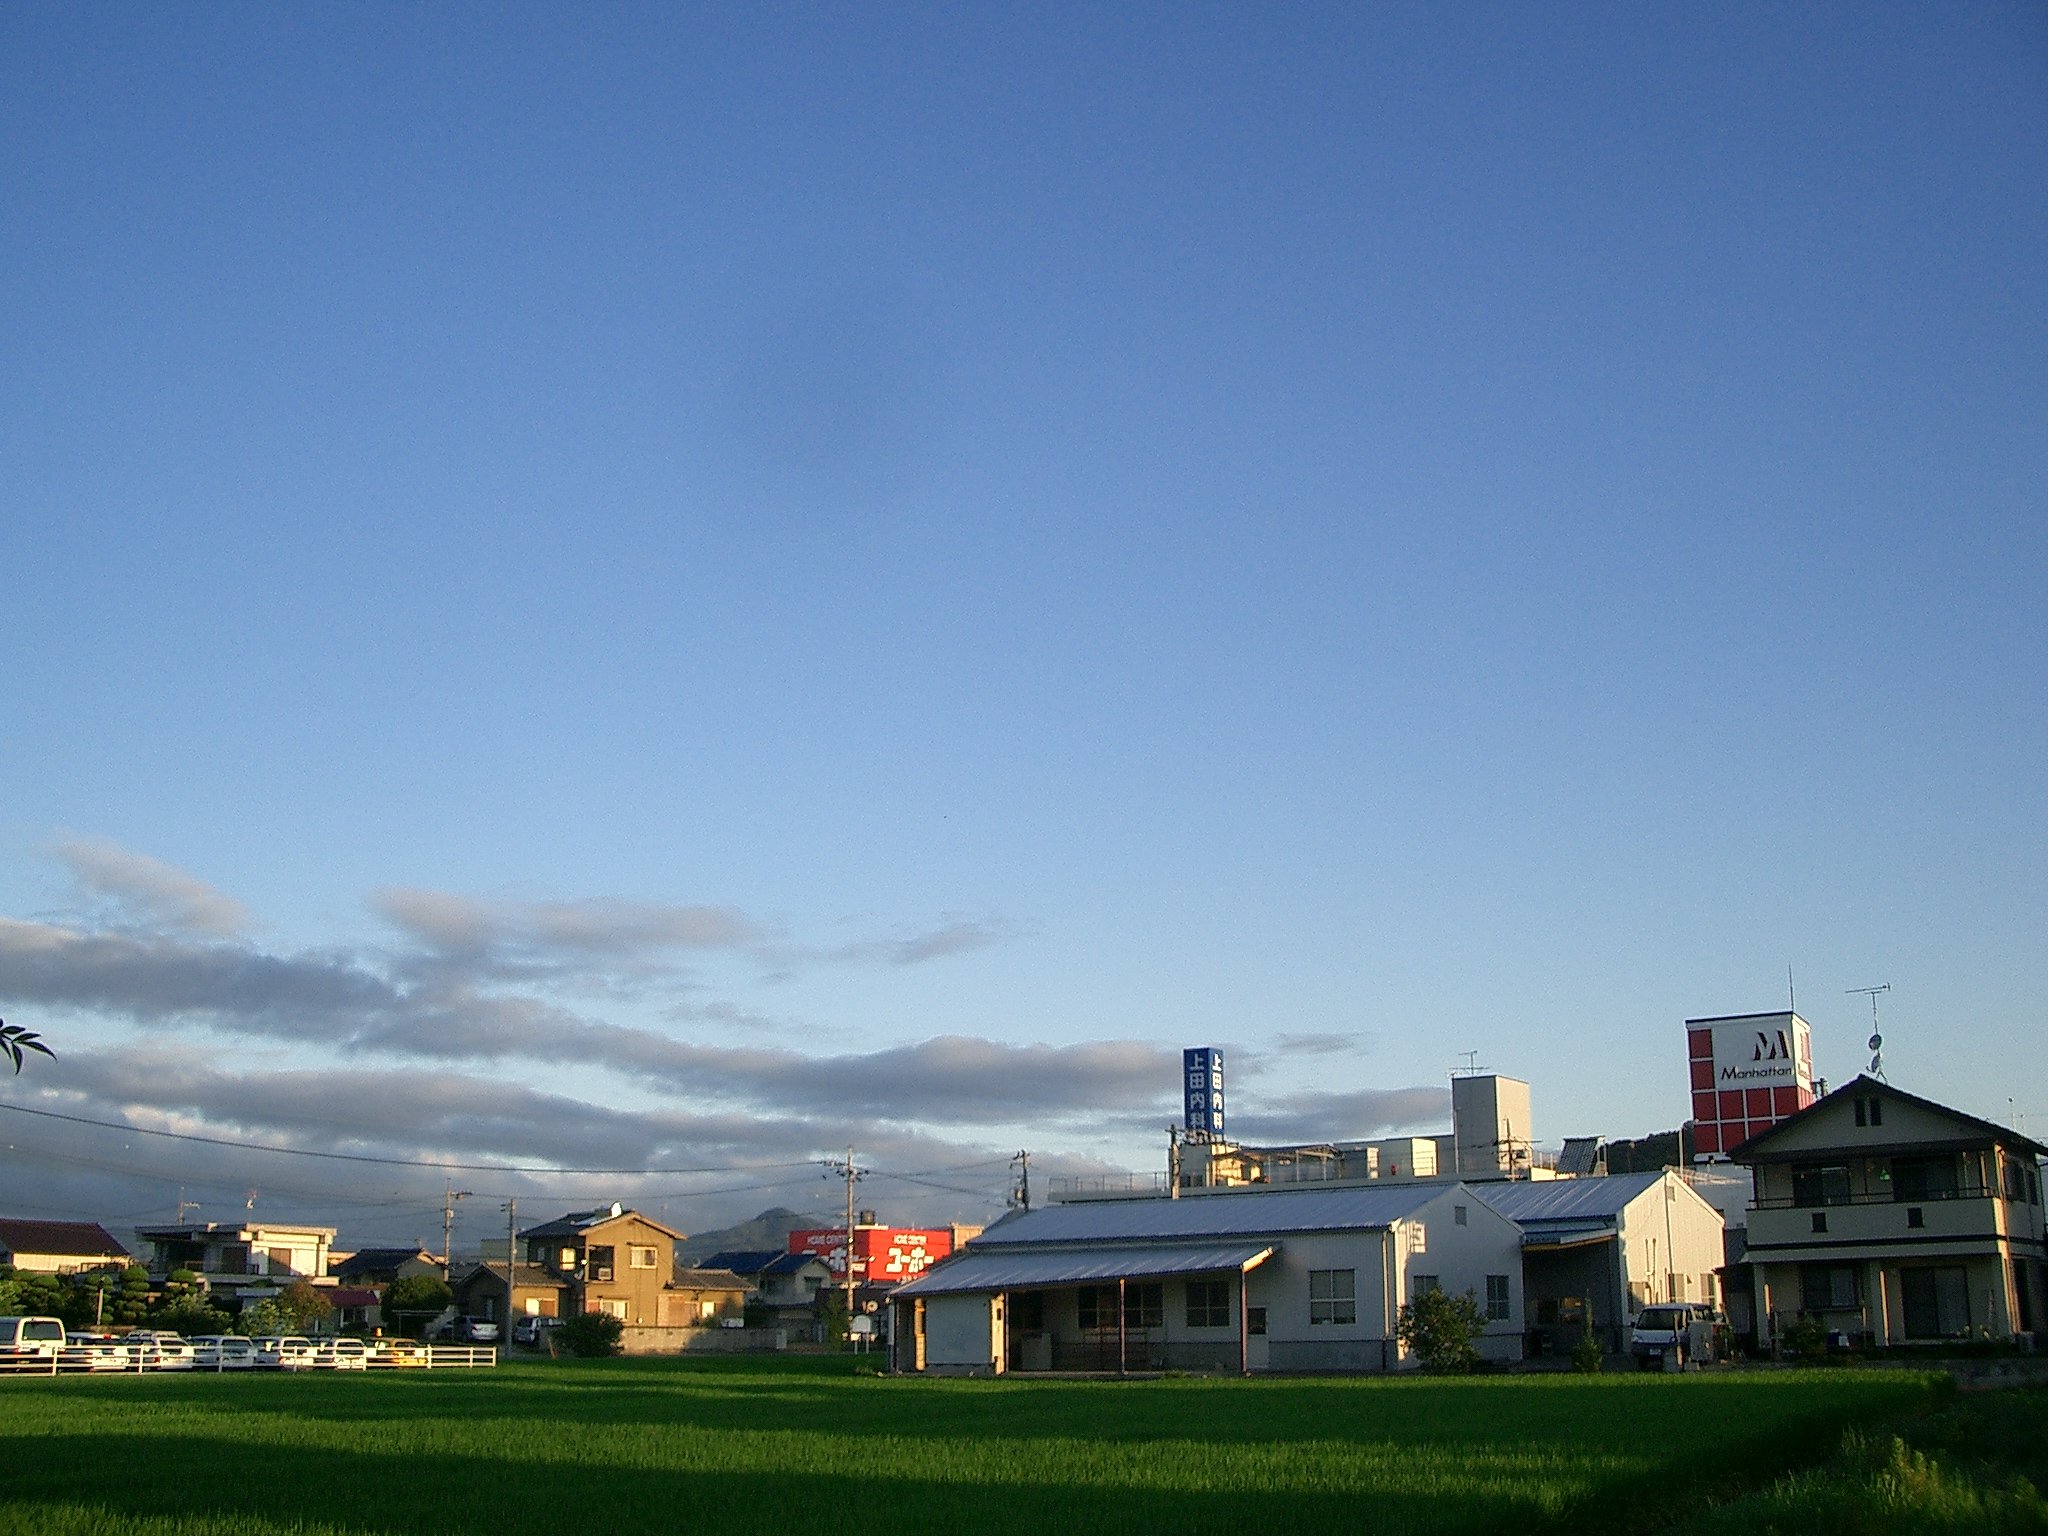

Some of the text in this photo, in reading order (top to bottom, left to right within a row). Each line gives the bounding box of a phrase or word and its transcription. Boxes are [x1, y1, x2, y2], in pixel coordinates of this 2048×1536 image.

[1189, 1053, 1205, 1129] 上田内科
[1211, 1053, 1223, 1129] 上田内科
[1720, 1065, 1792, 1080] Manhattan
[885, 1246, 935, 1273] ユーホー
